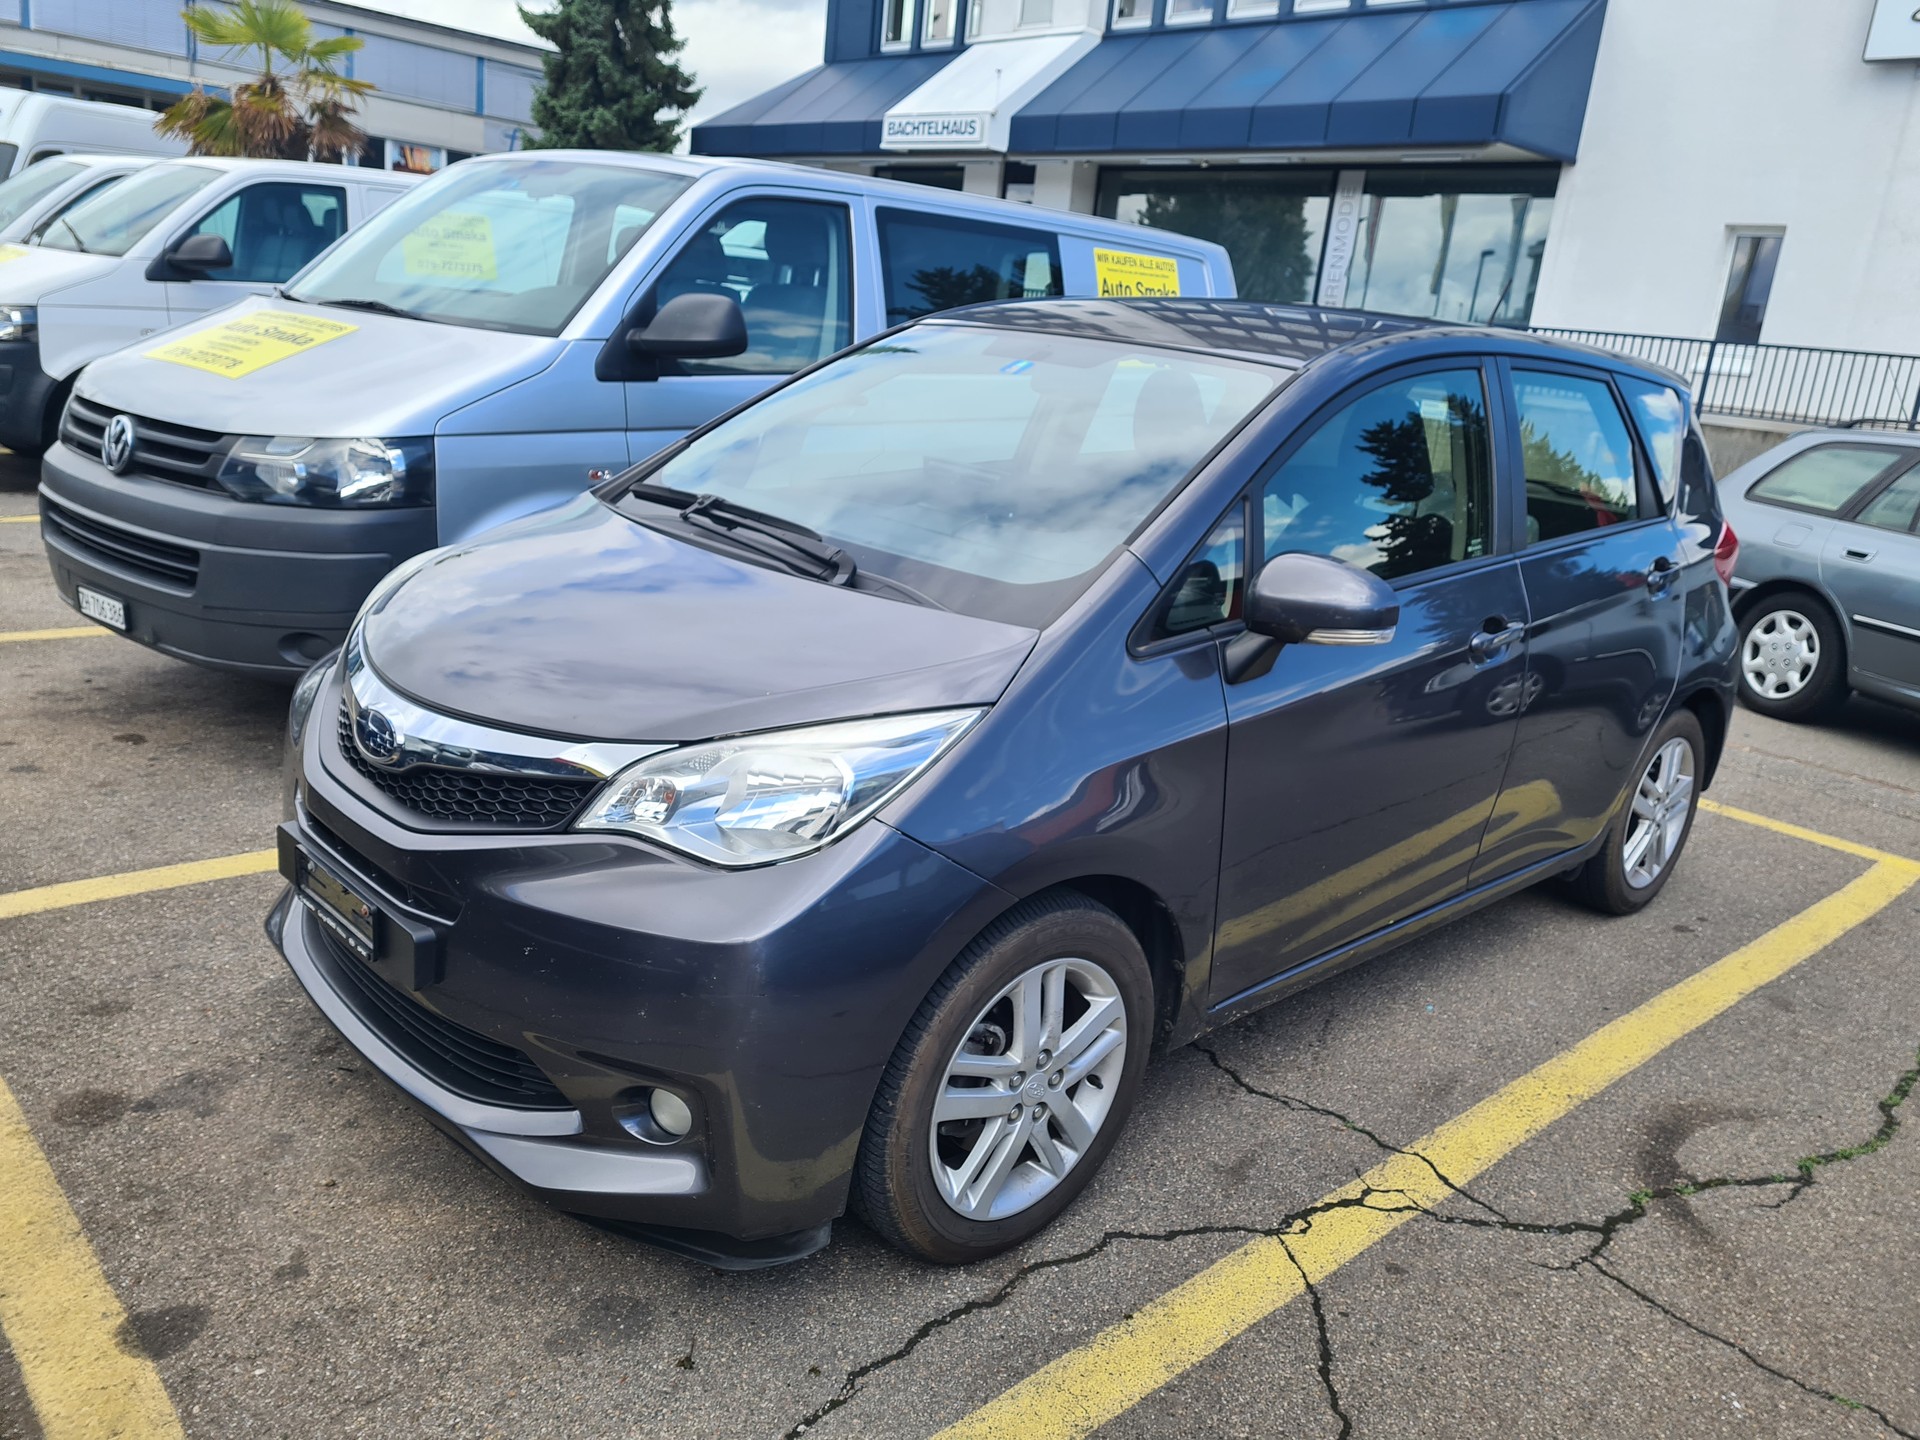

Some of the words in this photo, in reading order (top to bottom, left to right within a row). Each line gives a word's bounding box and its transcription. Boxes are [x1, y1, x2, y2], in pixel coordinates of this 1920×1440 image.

[888, 119, 976, 135] BACHTELHAUS
[1111, 255, 1137, 267] KAUFEN
[1101, 277, 1132, 297] Auto
